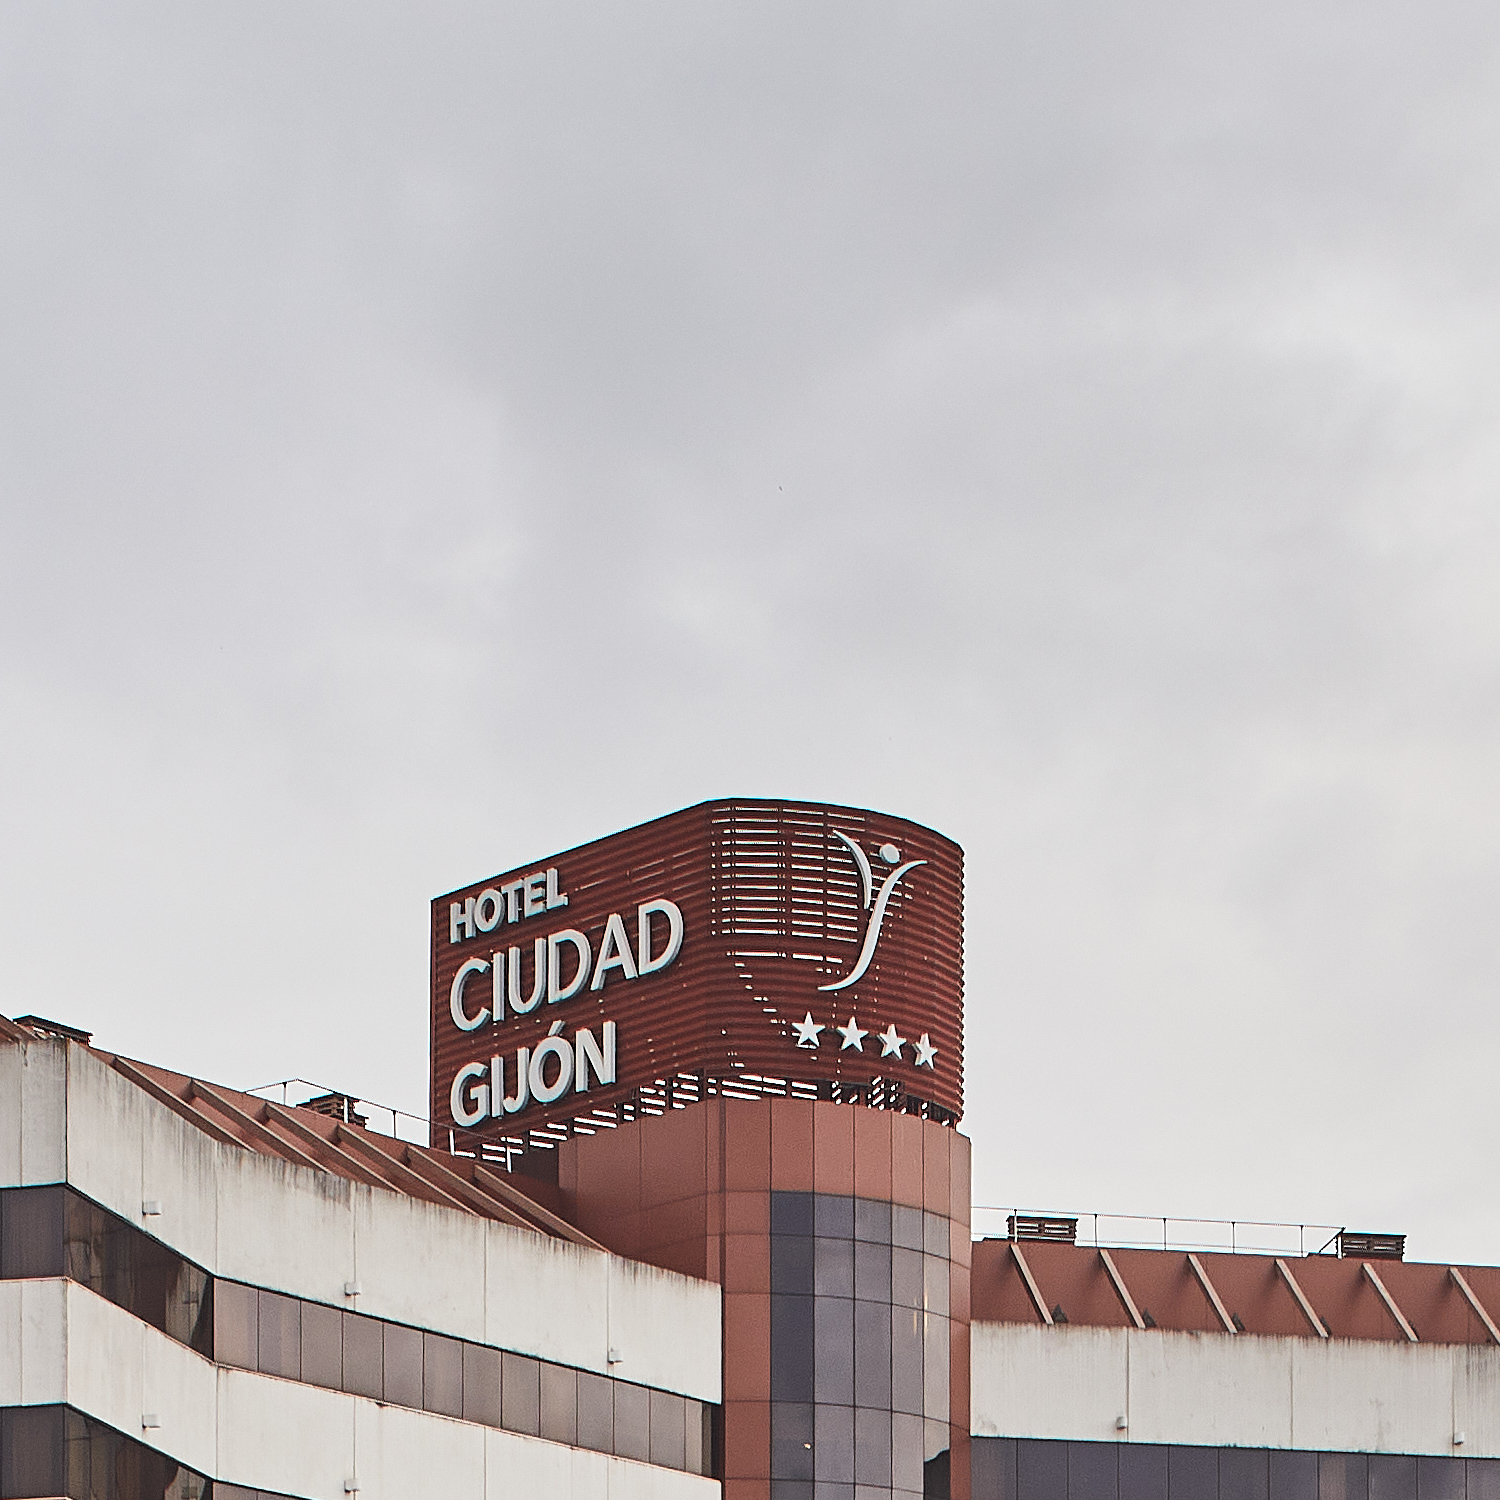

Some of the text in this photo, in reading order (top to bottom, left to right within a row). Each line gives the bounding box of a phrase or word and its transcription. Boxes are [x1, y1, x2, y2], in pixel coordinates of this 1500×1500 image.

[449, 868, 568, 943] HOTEL
[449, 898, 684, 1031] CIUDAD
[449, 1020, 617, 1128] GIJÓN
